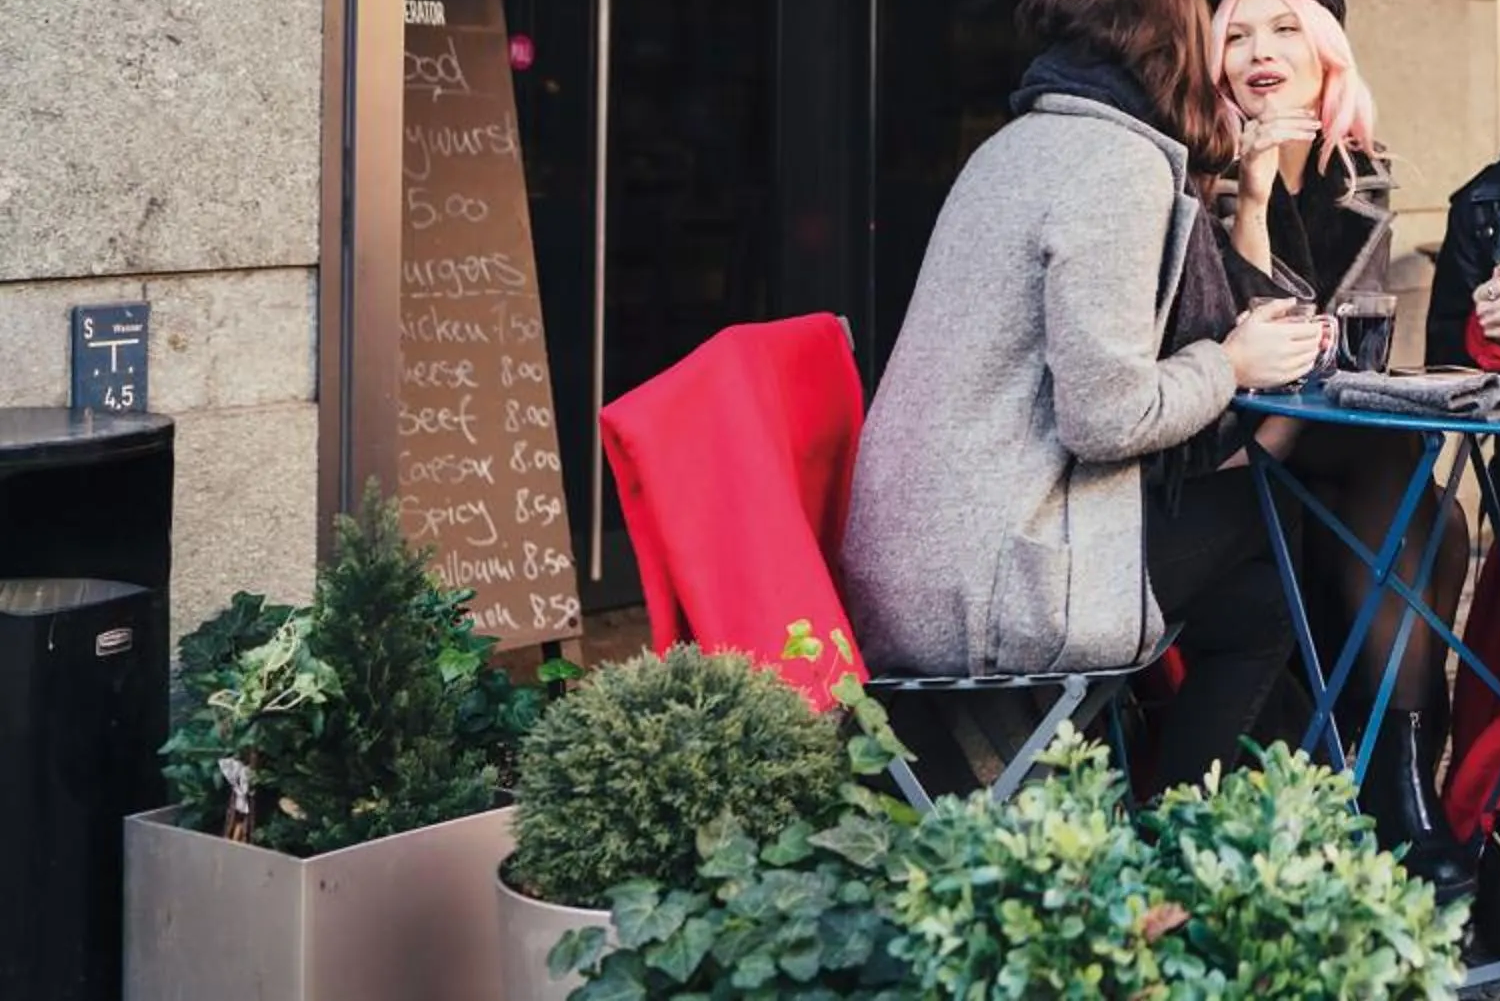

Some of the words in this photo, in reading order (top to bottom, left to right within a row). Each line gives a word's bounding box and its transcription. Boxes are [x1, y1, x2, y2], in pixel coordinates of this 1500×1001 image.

[404, 0, 447, 26] ERATOR
[404, 35, 470, 95] ood
[404, 111, 519, 180] ywurst
[403, 252, 526, 298] urgers
[401, 304, 490, 343] icken
